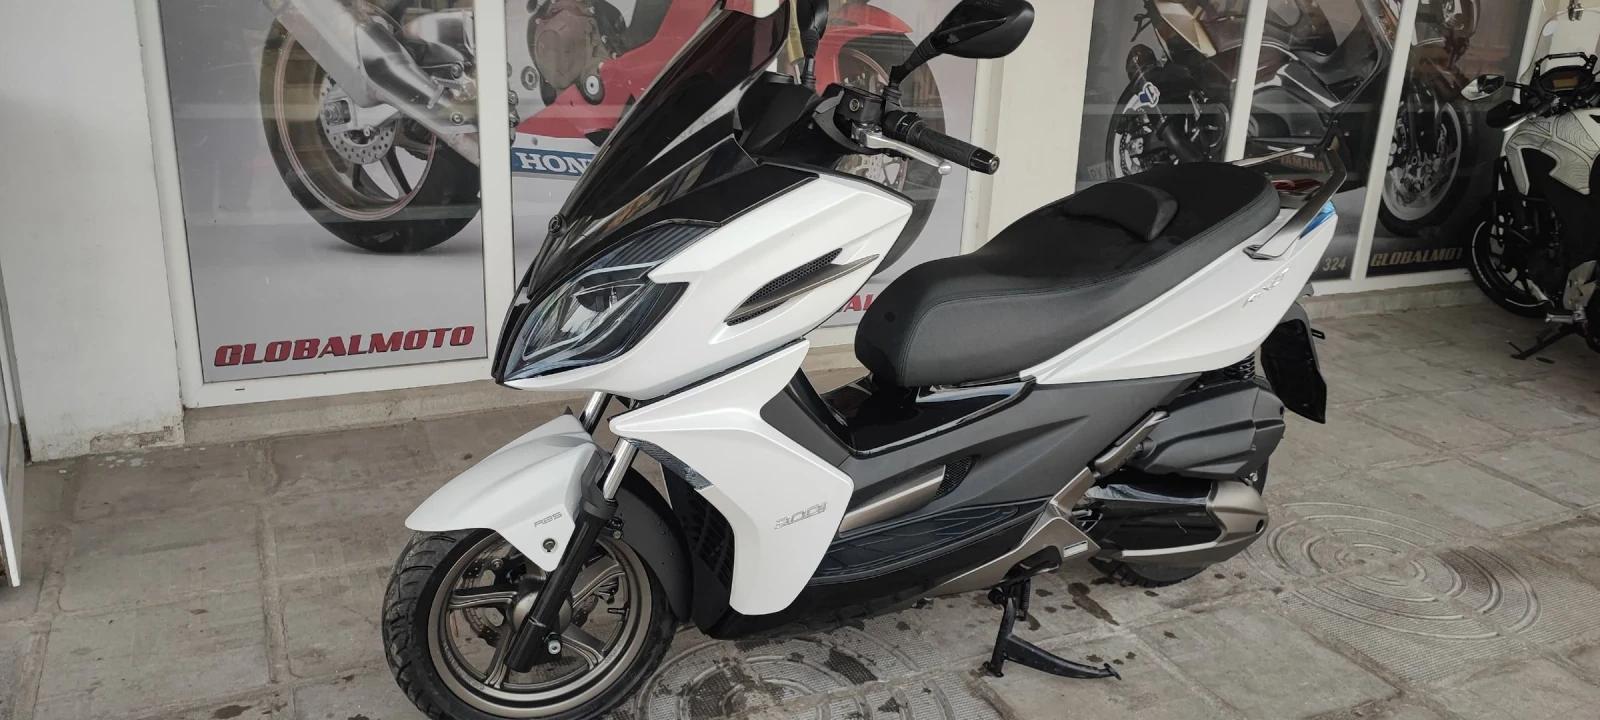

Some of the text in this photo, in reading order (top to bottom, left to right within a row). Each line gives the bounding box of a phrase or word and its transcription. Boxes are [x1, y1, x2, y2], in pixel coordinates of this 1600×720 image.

[1323, 257, 1347, 271] 324
[214, 326, 474, 366] GLOBALMOTO
[534, 511, 562, 528] ABS
